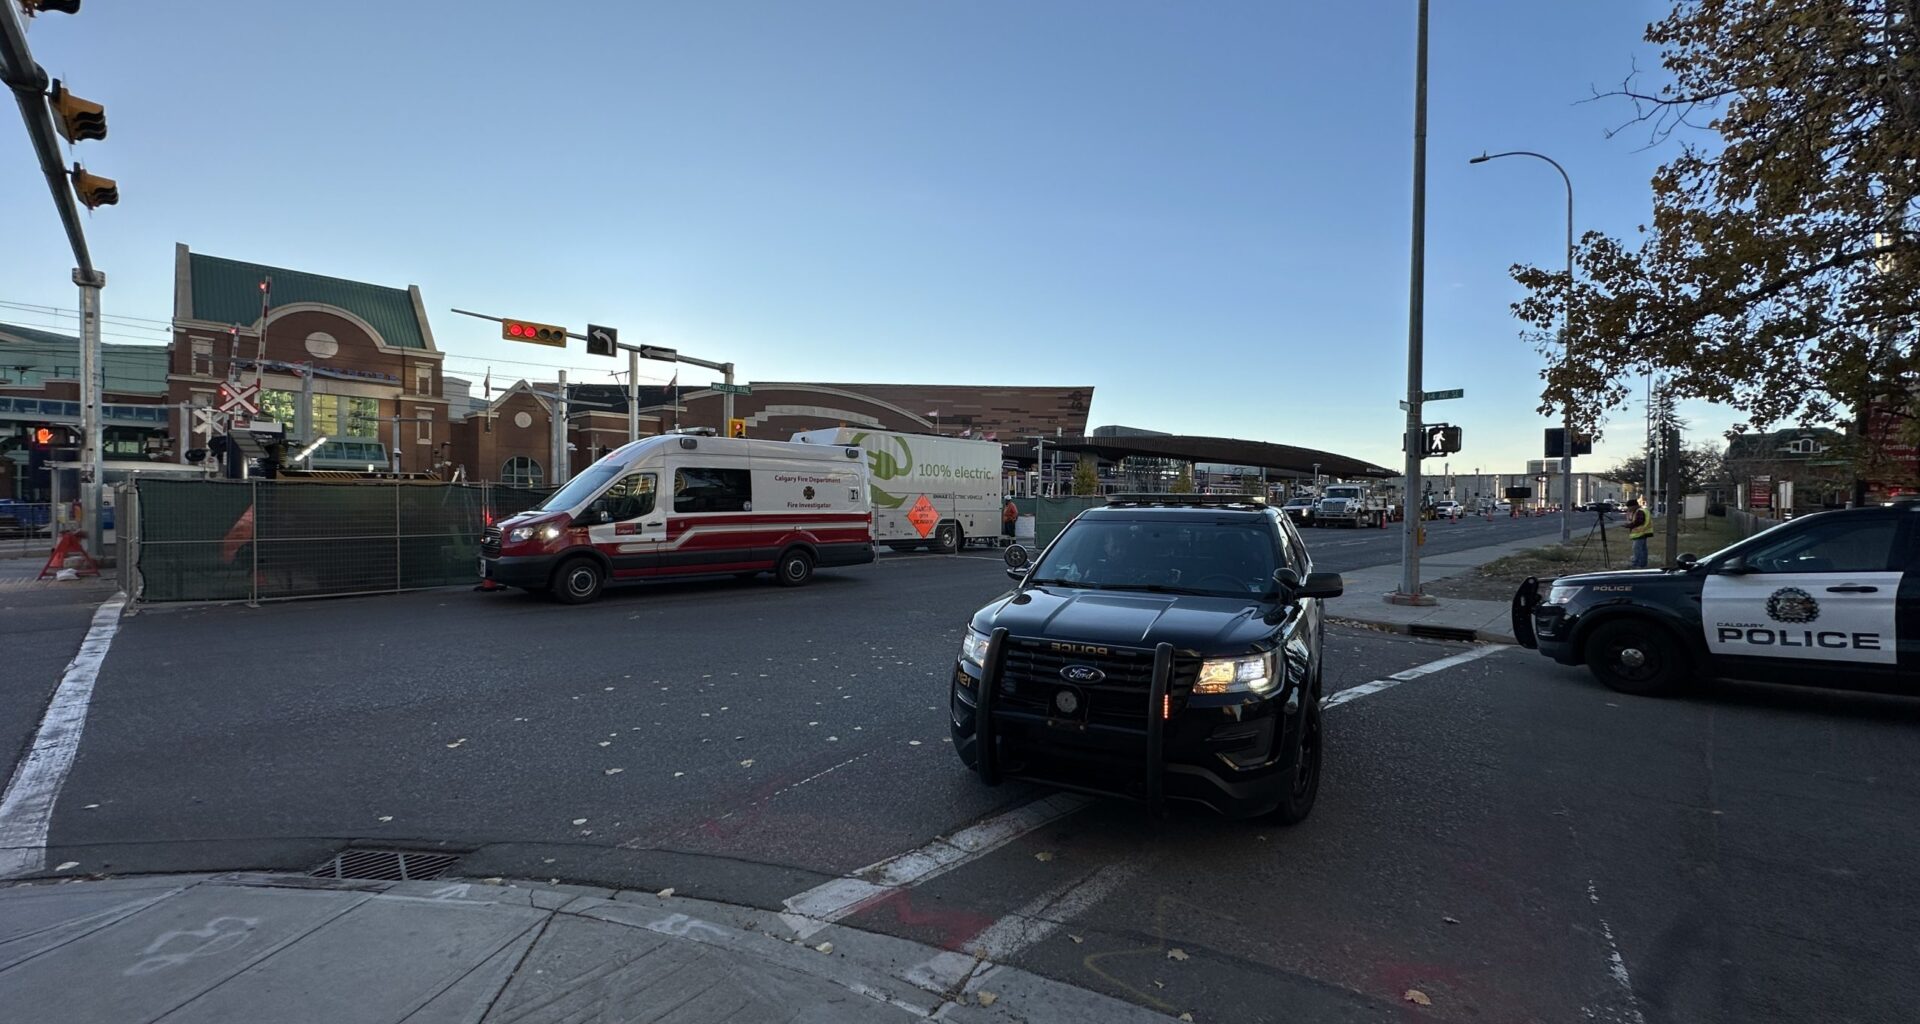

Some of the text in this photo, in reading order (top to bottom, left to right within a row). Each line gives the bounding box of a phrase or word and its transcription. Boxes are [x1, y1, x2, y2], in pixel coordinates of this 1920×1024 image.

[774, 474, 797, 483] Calgary
[808, 476, 841, 484] Department
[919, 463, 994, 480] 100% electric.
[1717, 628, 1881, 650] POLICE
[1067, 667, 1095, 680] Ford
